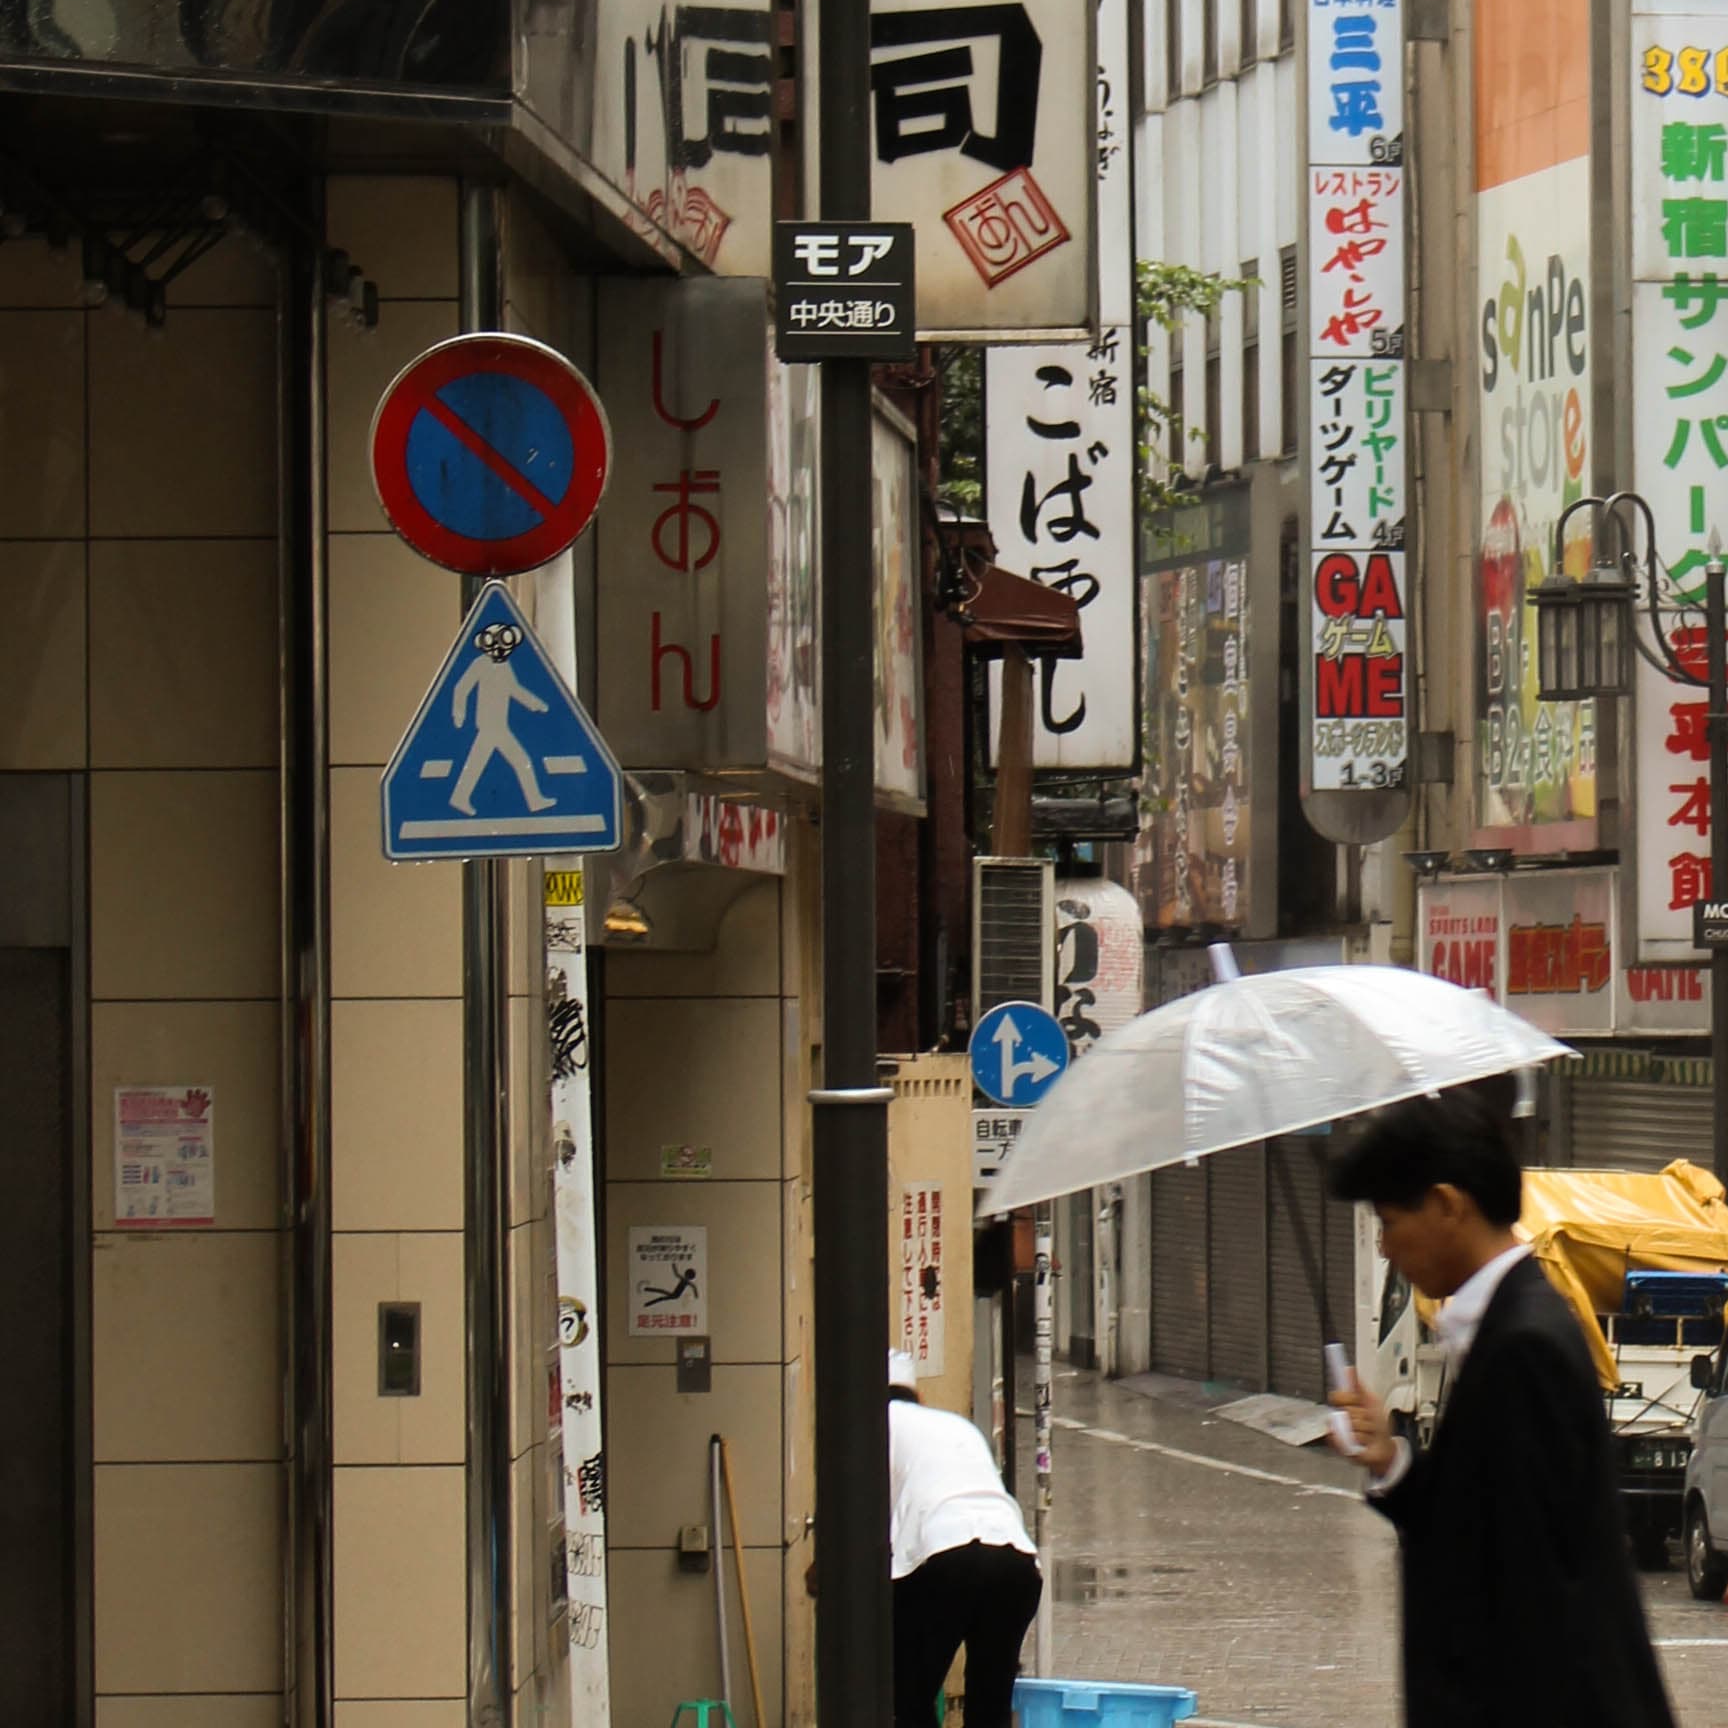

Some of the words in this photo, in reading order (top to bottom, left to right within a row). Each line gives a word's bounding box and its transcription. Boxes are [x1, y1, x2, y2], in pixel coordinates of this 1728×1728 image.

[1328, 14, 1385, 138] 三平
[1369, 135, 1403, 162] 6F
[1314, 171, 1401, 197] レストラン
[795, 235, 894, 276] モア
[789, 300, 896, 329] 中央通り
[1369, 327, 1403, 354] 5F
[1318, 363, 1358, 542] ダーツゲーム
[1360, 364, 1398, 518] ビリヤード
[1501, 385, 1586, 499] store
[1321, 612, 1395, 659] ゲーム
